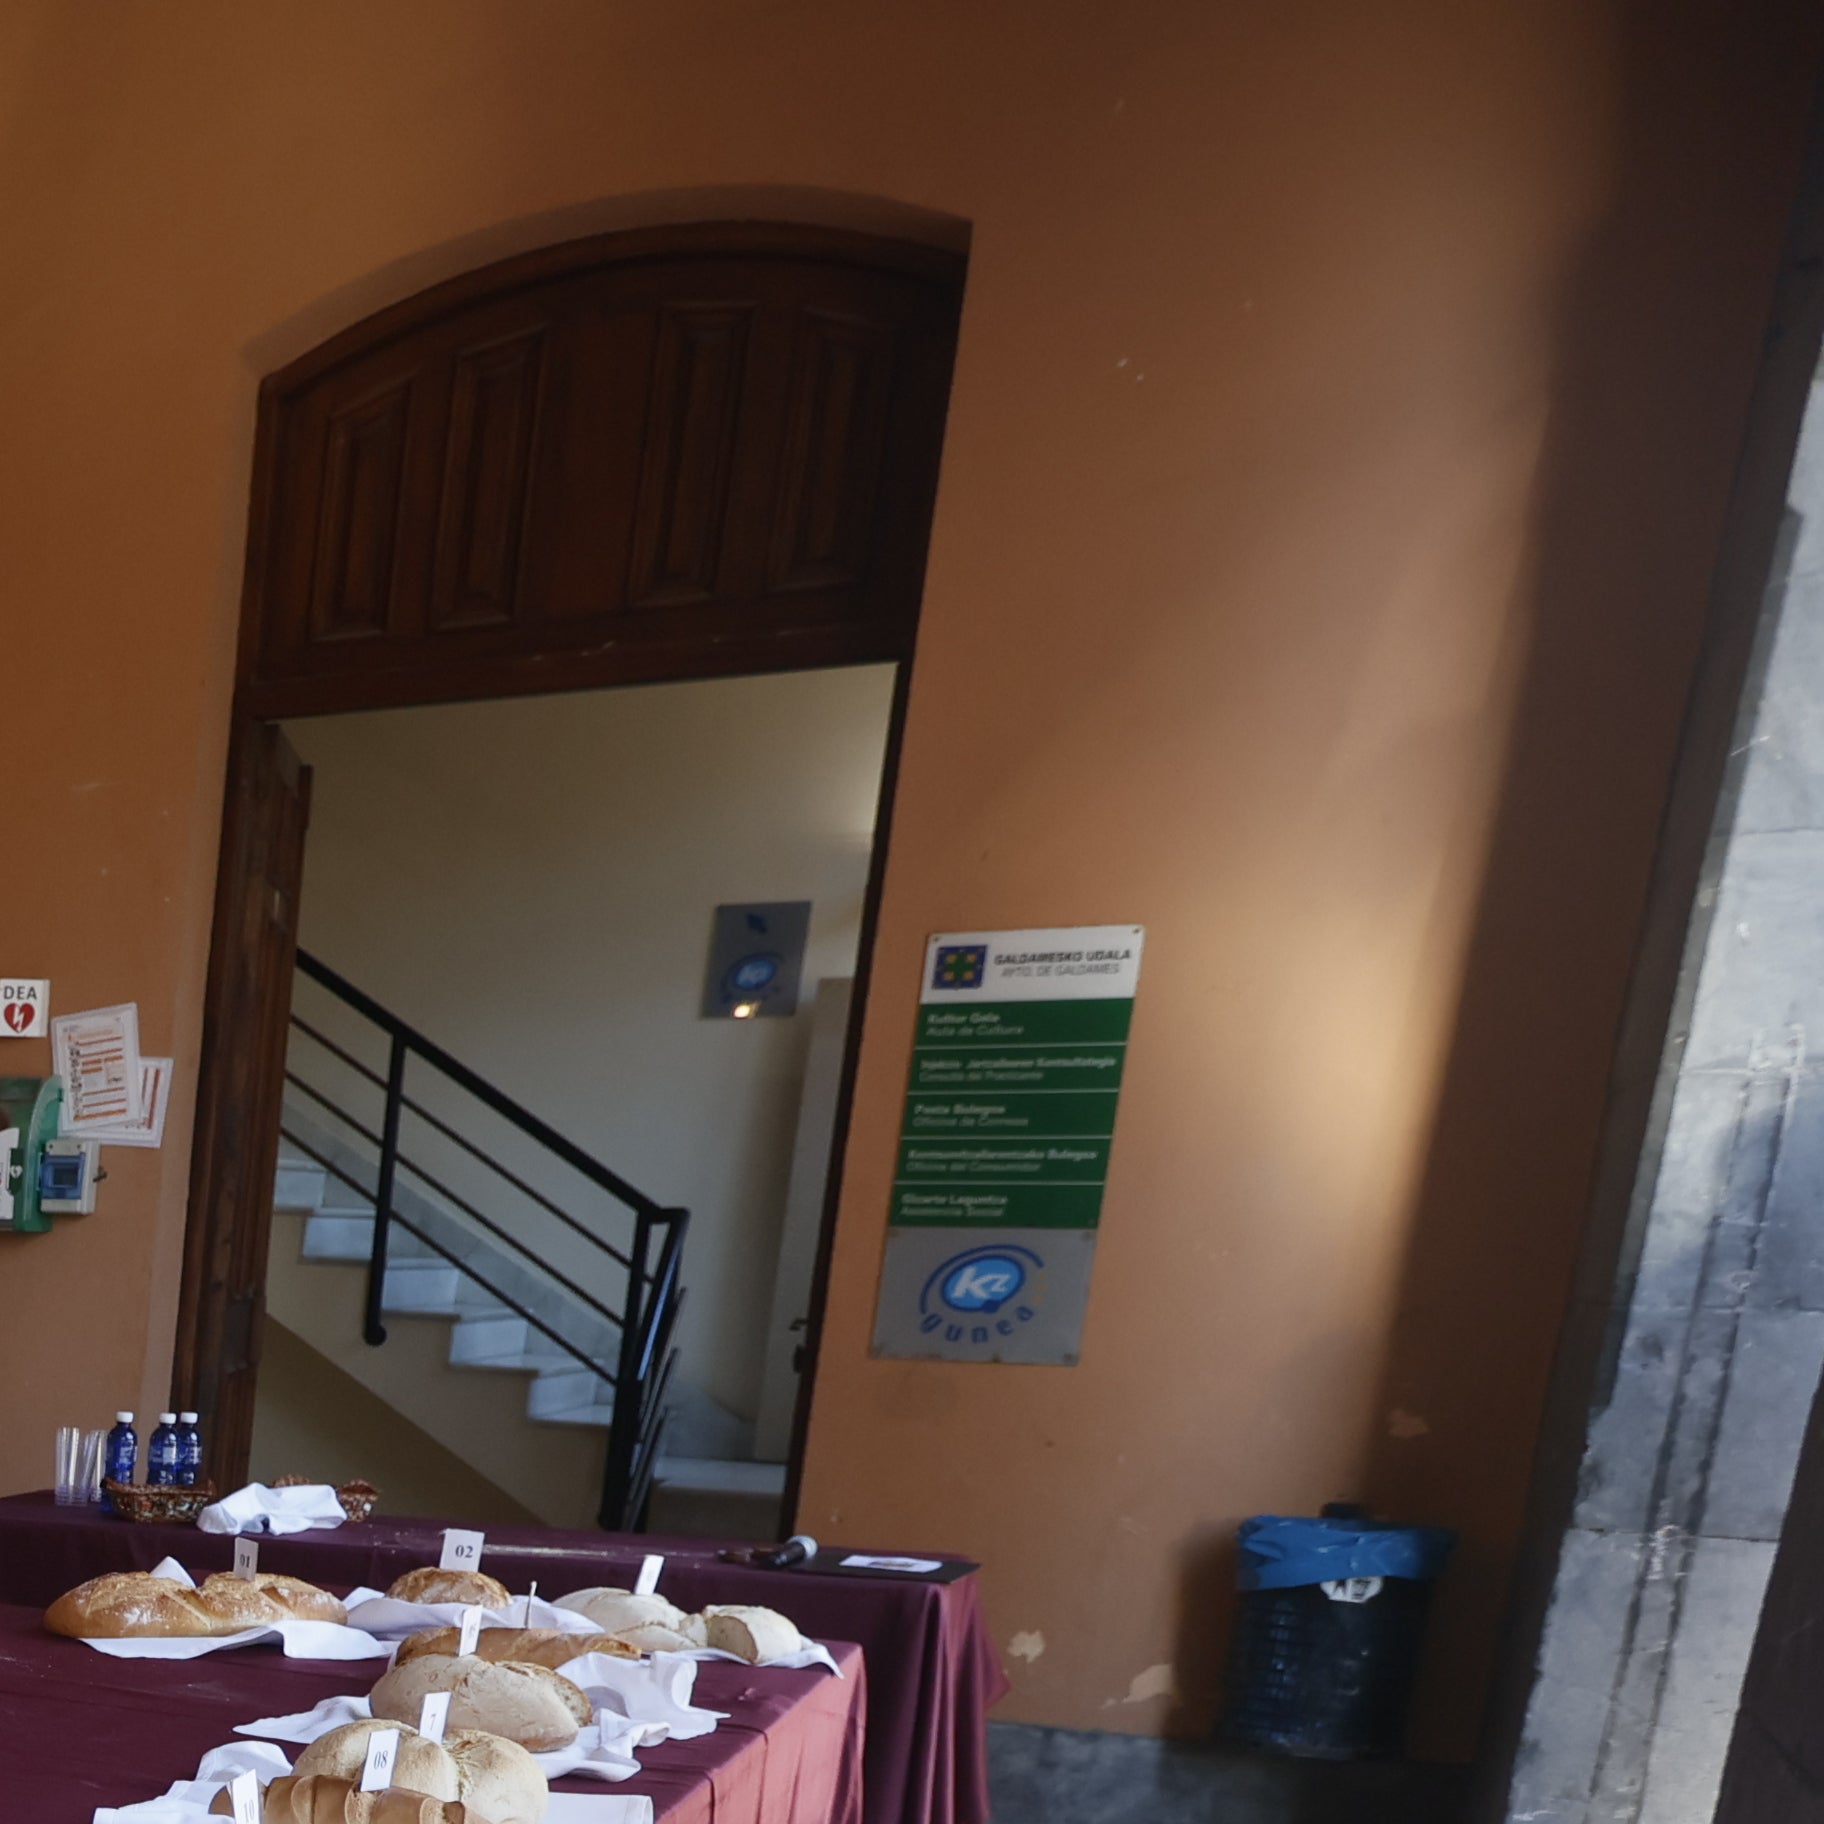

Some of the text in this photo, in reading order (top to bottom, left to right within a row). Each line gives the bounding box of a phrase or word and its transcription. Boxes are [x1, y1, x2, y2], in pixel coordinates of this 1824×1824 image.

[4, 986, 37, 1000] DEA
[920, 1305, 1034, 1343] gunea
[455, 1545, 473, 1558] 02
[240, 1553, 250, 1568] 01
[373, 1750, 389, 1770] 08
[244, 1799, 255, 1824] 10
